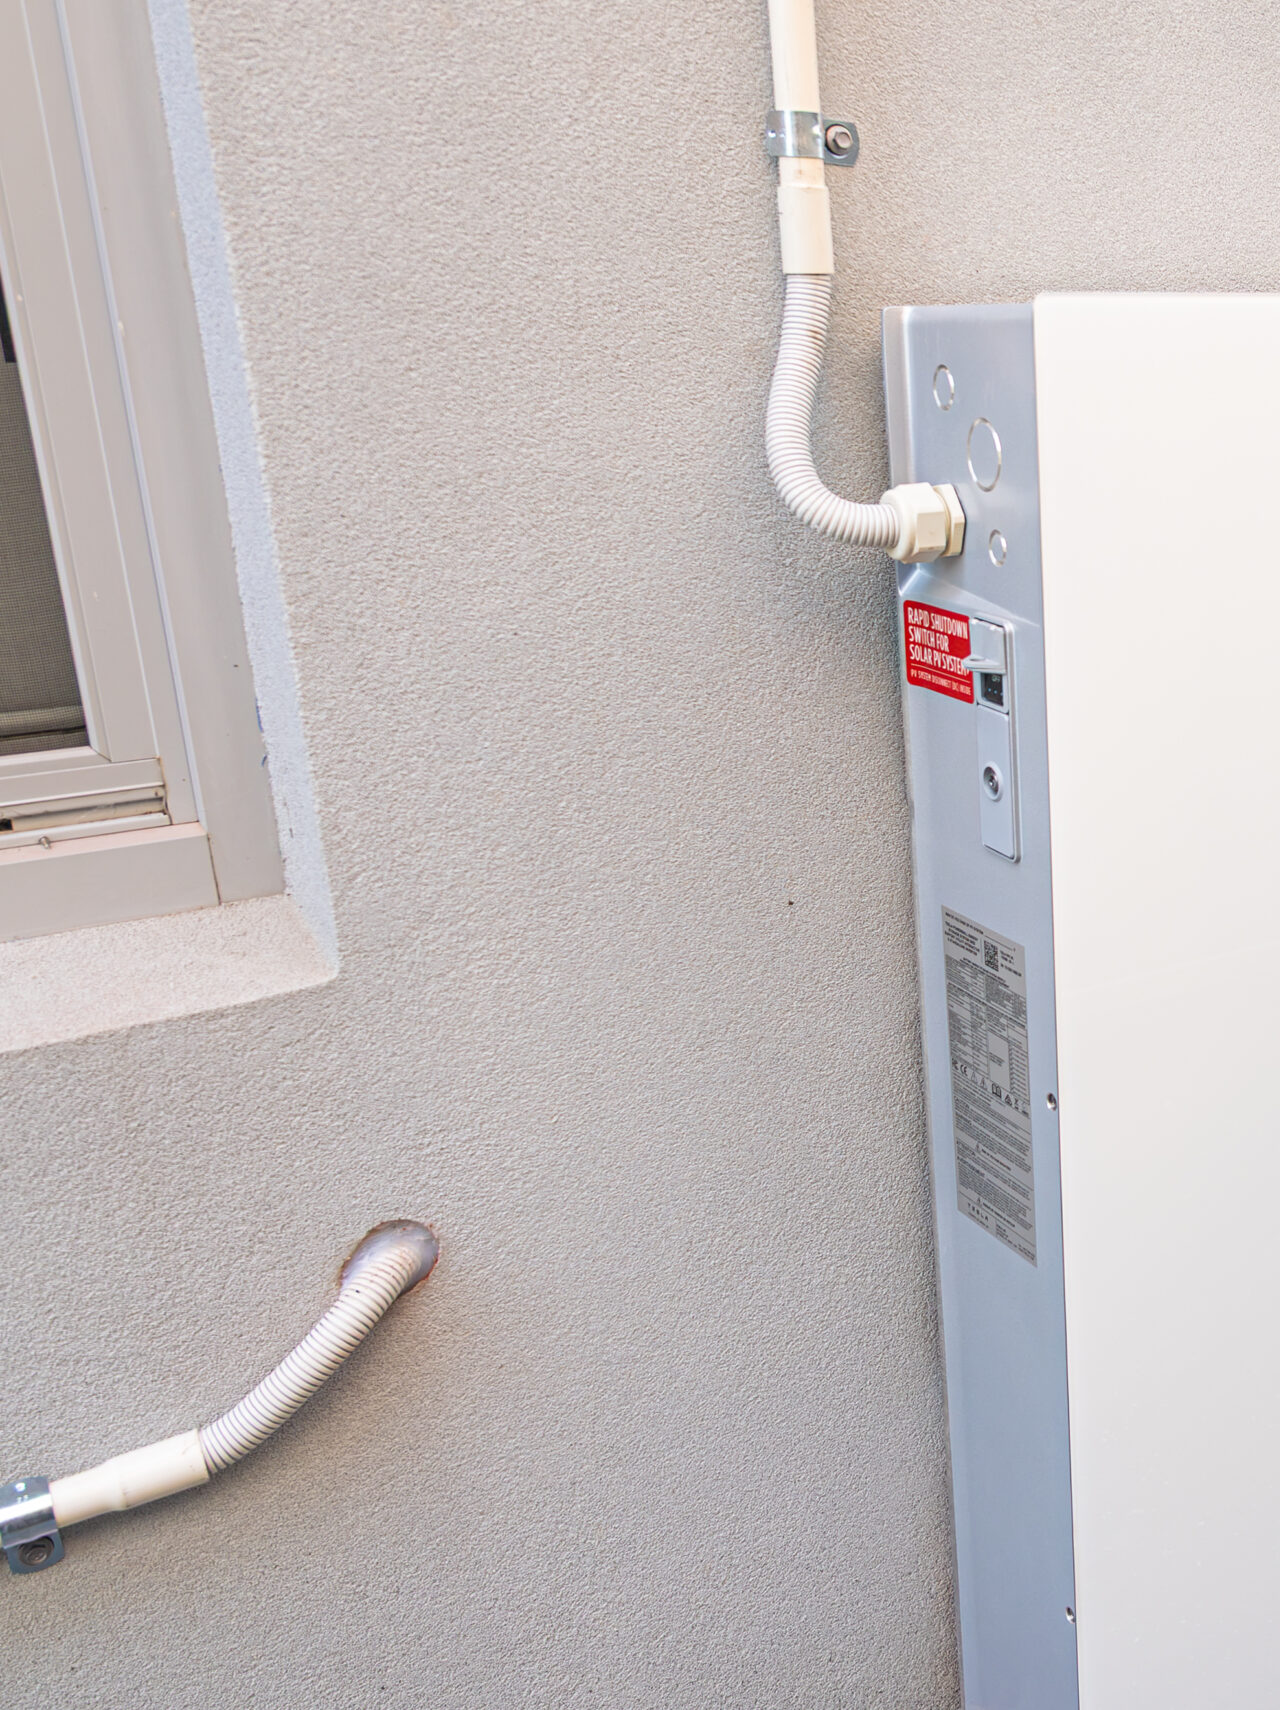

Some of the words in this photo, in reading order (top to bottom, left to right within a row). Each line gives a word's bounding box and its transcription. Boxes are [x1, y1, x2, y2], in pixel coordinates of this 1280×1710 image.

[908, 607, 930, 627] RAPID
[931, 613, 968, 640] SHUTDOWN
[909, 626, 935, 648] SWITCH
[936, 633, 949, 652] FOR
[909, 644, 933, 665] SOLAR
[933, 650, 942, 669] PV
